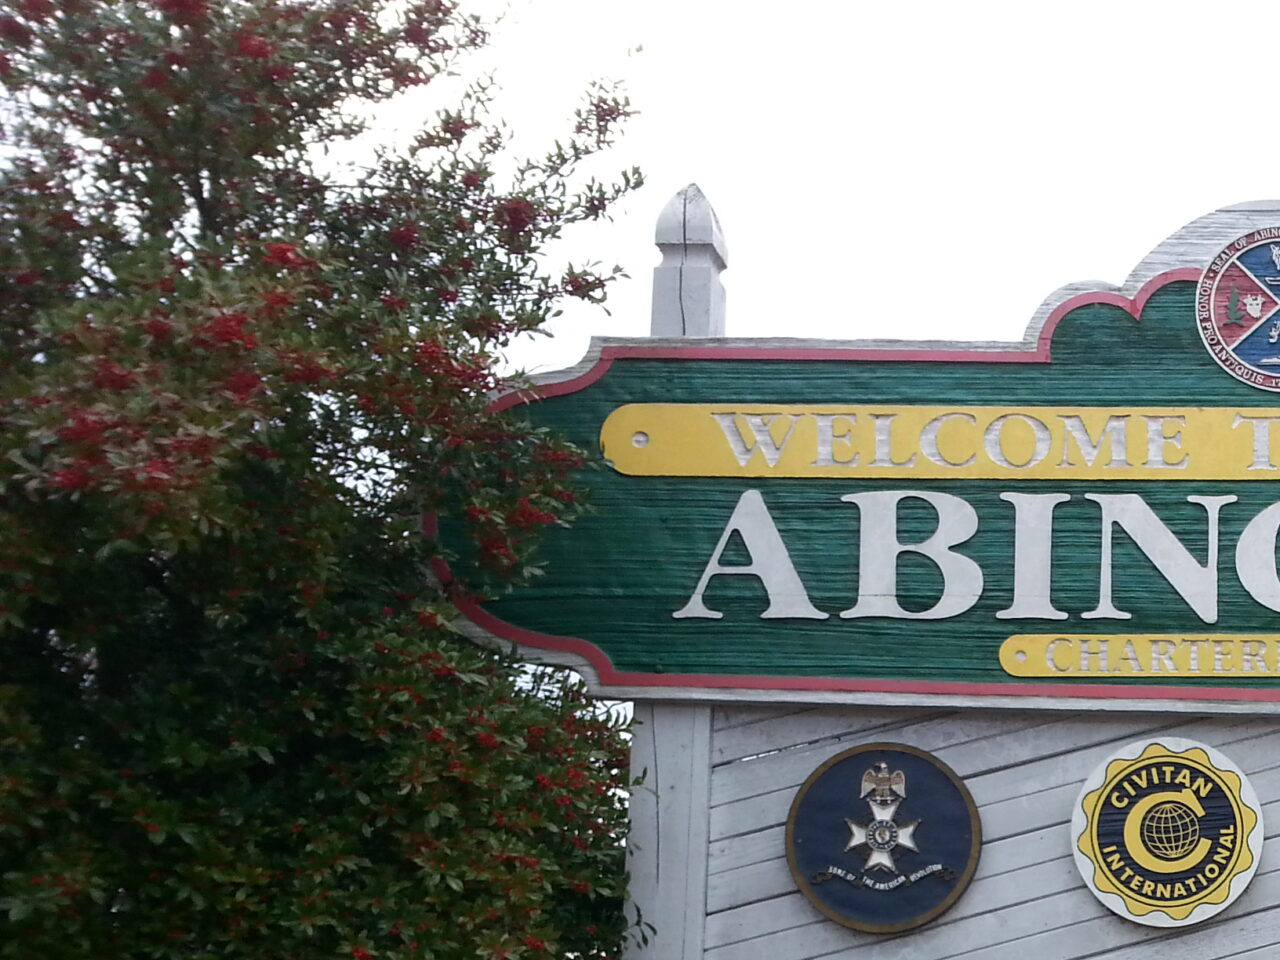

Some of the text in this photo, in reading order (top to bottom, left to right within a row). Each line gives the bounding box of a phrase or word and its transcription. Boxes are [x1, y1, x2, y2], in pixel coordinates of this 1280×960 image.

[1212, 249, 1234, 272] SEAL
[1235, 237, 1247, 249] OF
[1199, 280, 1263, 384] HONOR PRO ANTIQUIS
[711, 412, 1190, 469] WELCOME
[1111, 766, 1213, 808] CIVITAN
[863, 876, 874, 887] THE
[1103, 825, 1235, 898] INTERNATIONAL
